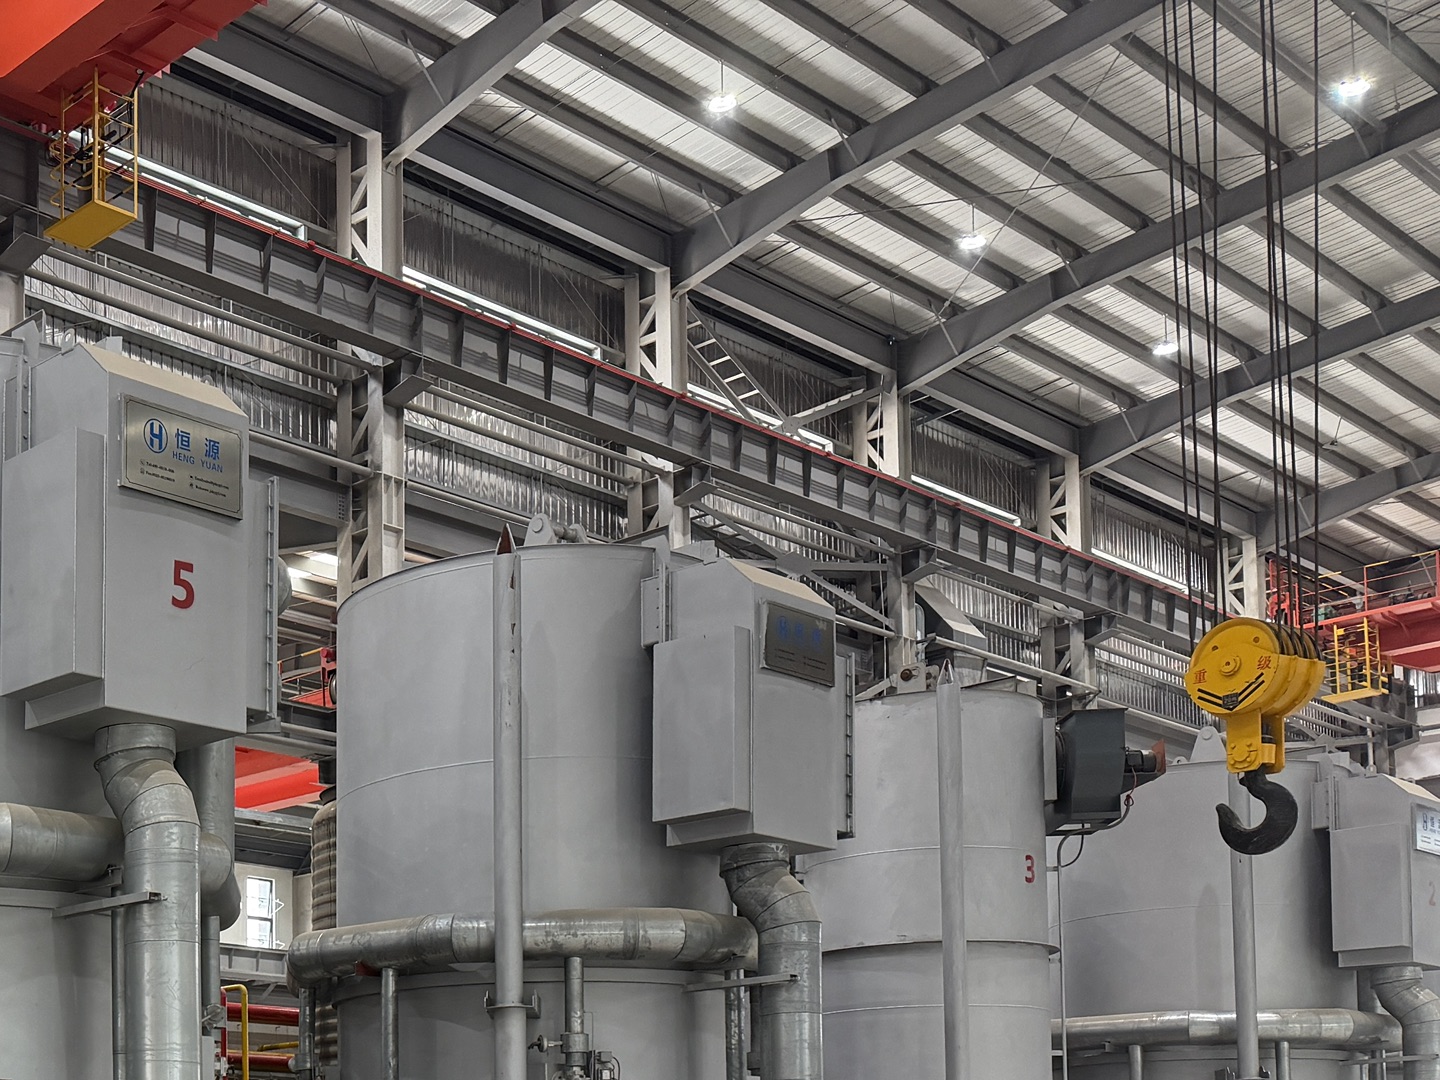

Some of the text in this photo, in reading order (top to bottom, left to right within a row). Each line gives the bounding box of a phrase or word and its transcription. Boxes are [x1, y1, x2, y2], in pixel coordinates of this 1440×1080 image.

[175, 428, 220, 460] 恒源
[172, 450, 223, 473] HENG YUAN
[172, 560, 194, 609] 5
[1025, 855, 1035, 883] 3
